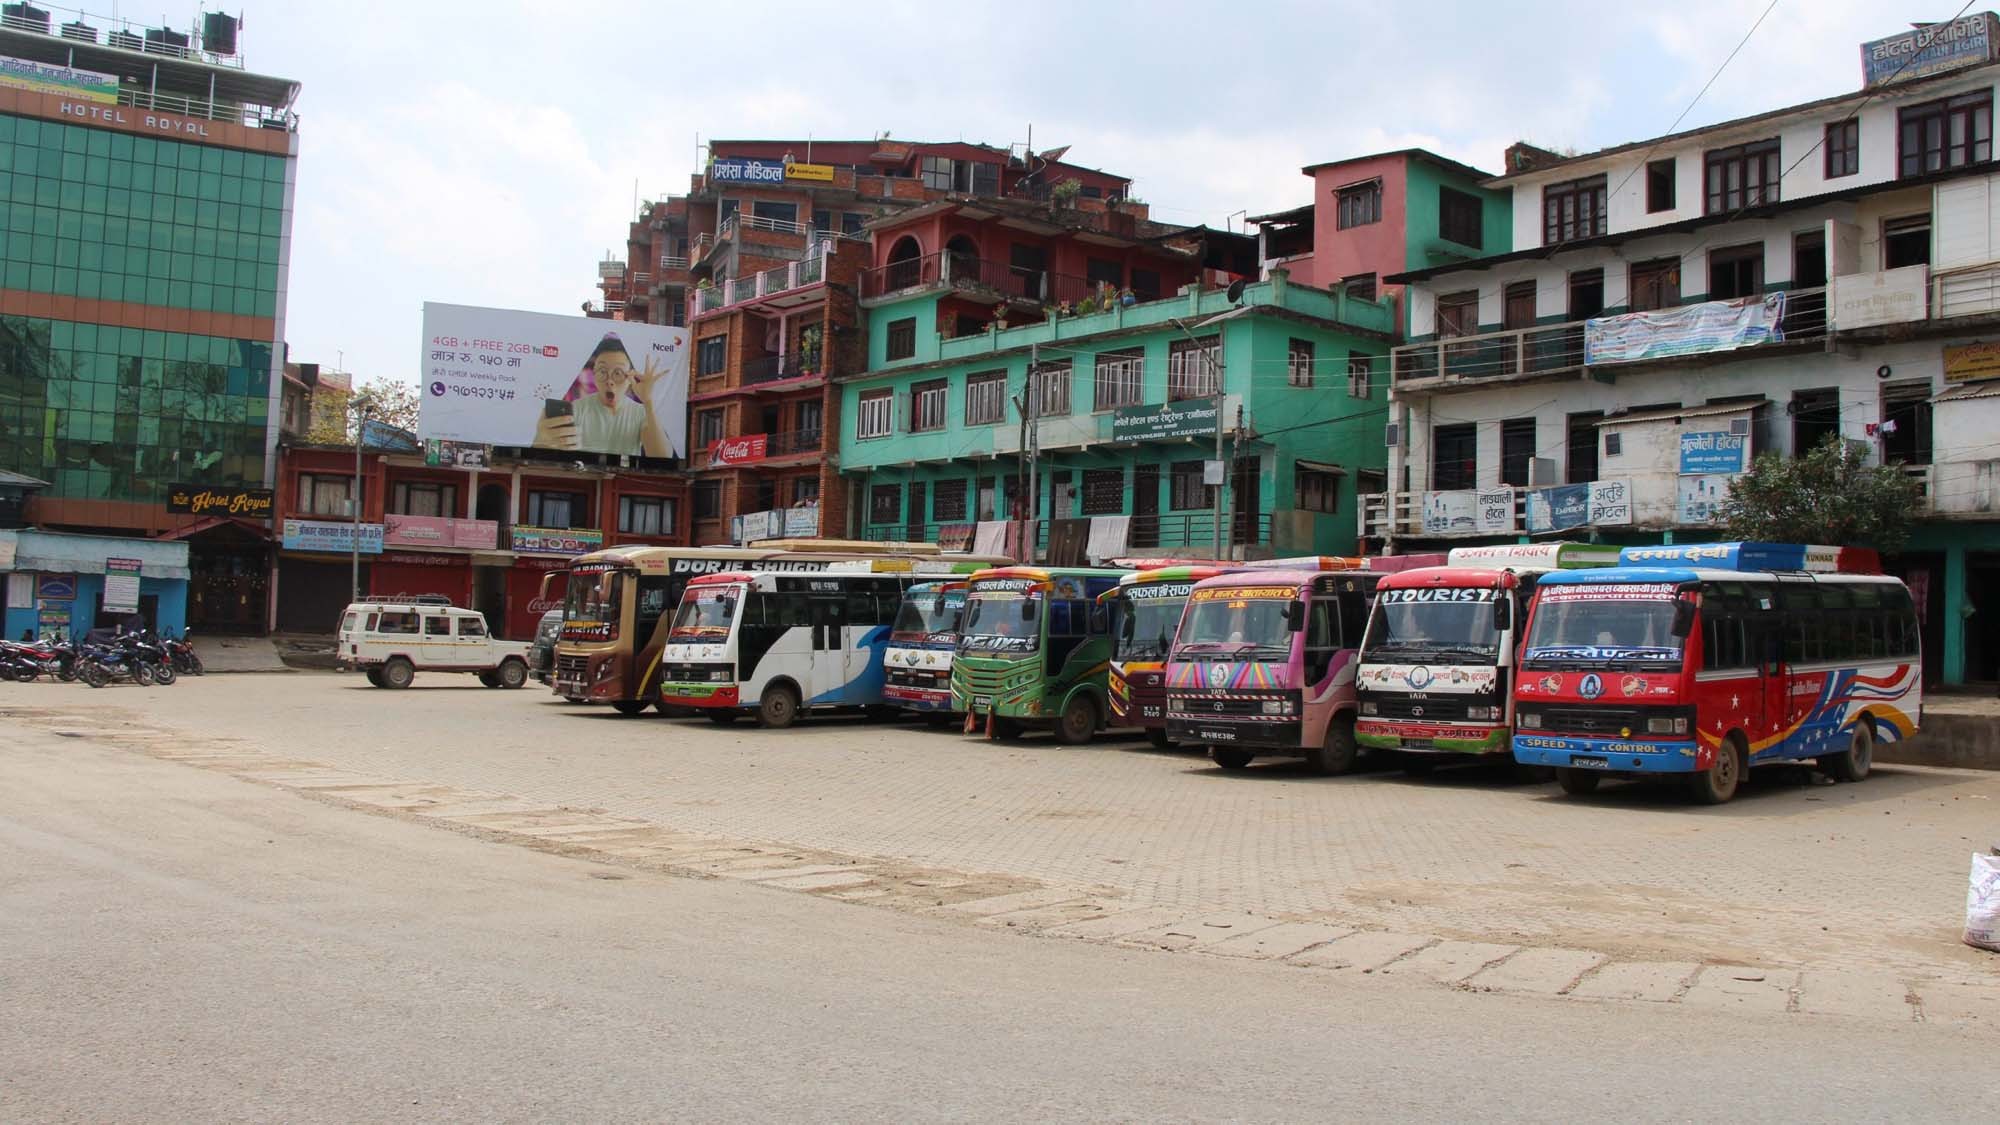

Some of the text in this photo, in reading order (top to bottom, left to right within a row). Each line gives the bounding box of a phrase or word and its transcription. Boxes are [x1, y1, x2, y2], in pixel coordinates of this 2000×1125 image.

[1872, 37, 1914, 60] होटल
[61, 102, 209, 136] HOTEL ROYAL
[714, 161, 784, 180] प्रशंसा मेडिकल
[432, 336, 458, 348] 4GB
[473, 339, 504, 351] FREE
[507, 342, 531, 354] 2GB
[652, 343, 675, 353] Ncell
[431, 350, 456, 362] मात्र
[479, 354, 503, 366] १५०
[507, 358, 521, 368] मा
[470, 372, 497, 382] Weekly
[499, 374, 516, 382] Pack
[1716, 433, 1741, 450] होटल
[723, 441, 751, 460] Coca-Cola
[192, 491, 271, 513] Hotel Royal
[1485, 507, 1505, 520] होटल
[1592, 503, 1626, 521] होटल
[1684, 545, 1729, 562] देवी
[674, 559, 745, 573] DORJE
[751, 561, 829, 573] SHUGD
[1169, 585, 1192, 597] सफ
[1215, 590, 1236, 598] नगर
[1240, 589, 1281, 598] यातायात
[1391, 588, 1491, 602] TOURIST
[1550, 584, 1575, 595] पश्चिम
[1576, 584, 1599, 594] नेपाल
[1599, 584, 1612, 594] बस
[961, 635, 1026, 651] DELUXE
[1527, 738, 1659, 753] SPEED CONTROL
